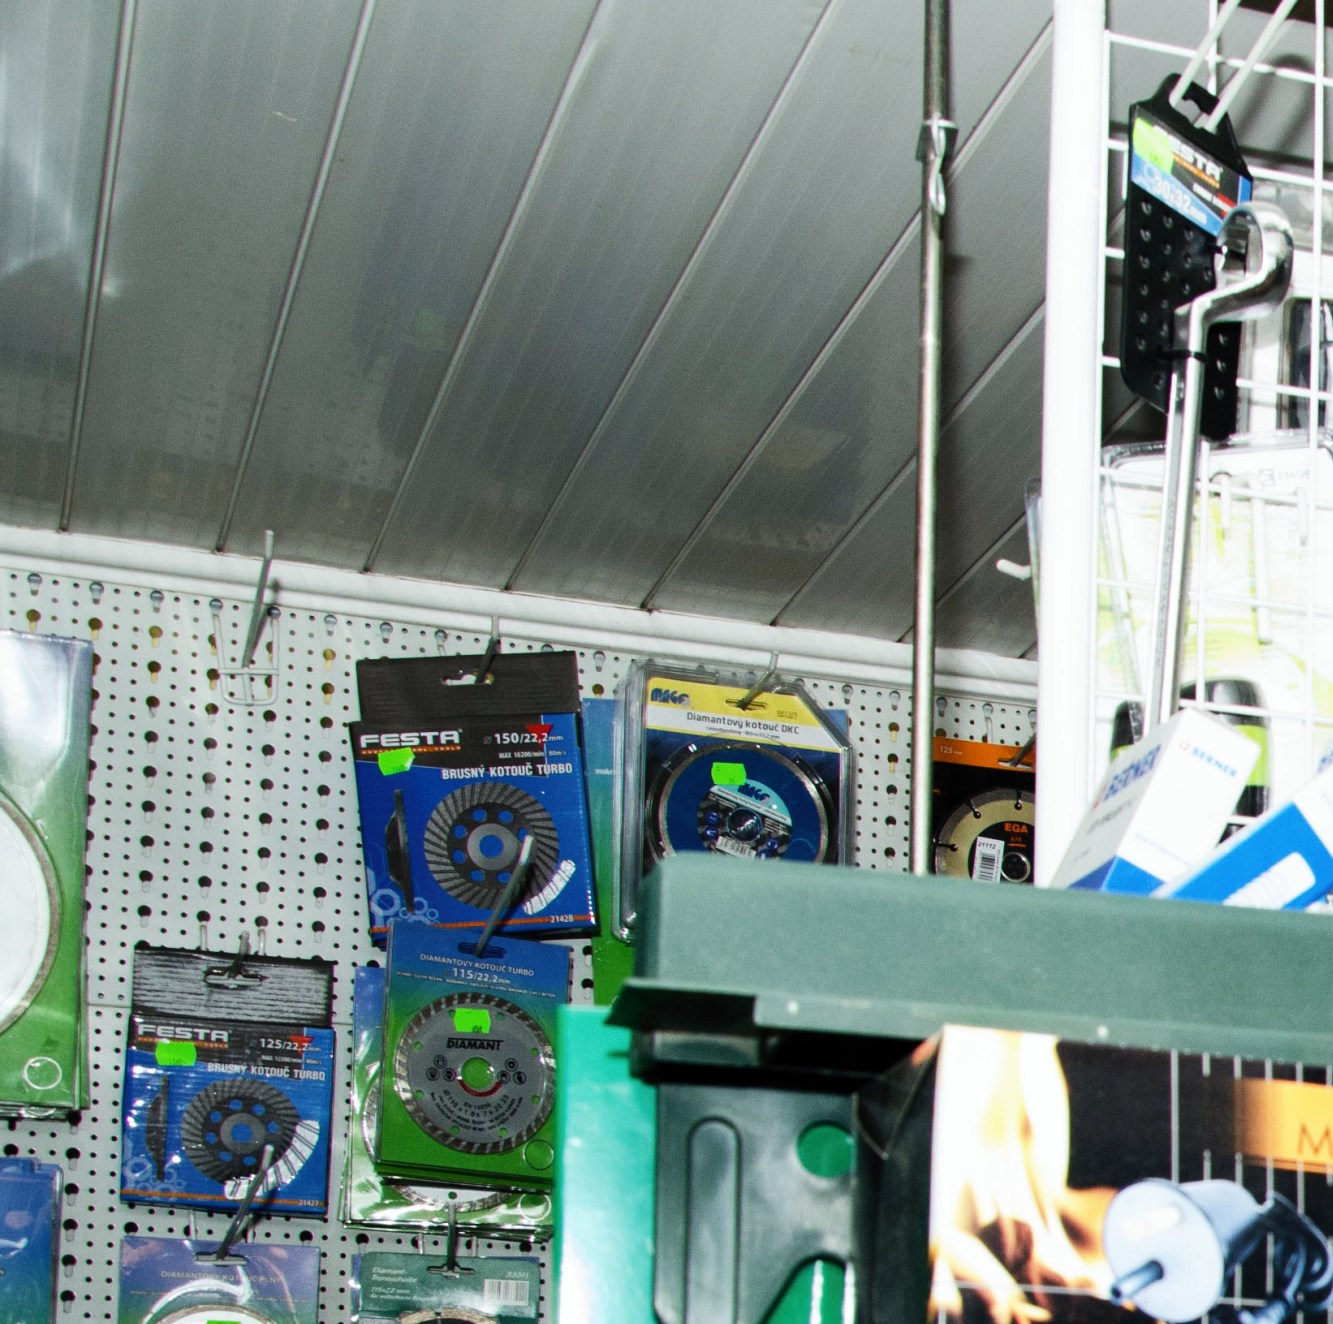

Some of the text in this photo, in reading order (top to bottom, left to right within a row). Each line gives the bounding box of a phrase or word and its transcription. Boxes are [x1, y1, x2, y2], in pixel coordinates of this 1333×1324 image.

[781, 724, 800, 735] DKC
[360, 730, 461, 748] FESTA
[441, 762, 573, 780] BRUSNÝ KOTOUČ TURBO
[138, 1024, 229, 1041] FESTA
[447, 1038, 504, 1051] DIAMANT
[207, 1061, 326, 1081] BRUSNÝ KOTOUČ TURBO
